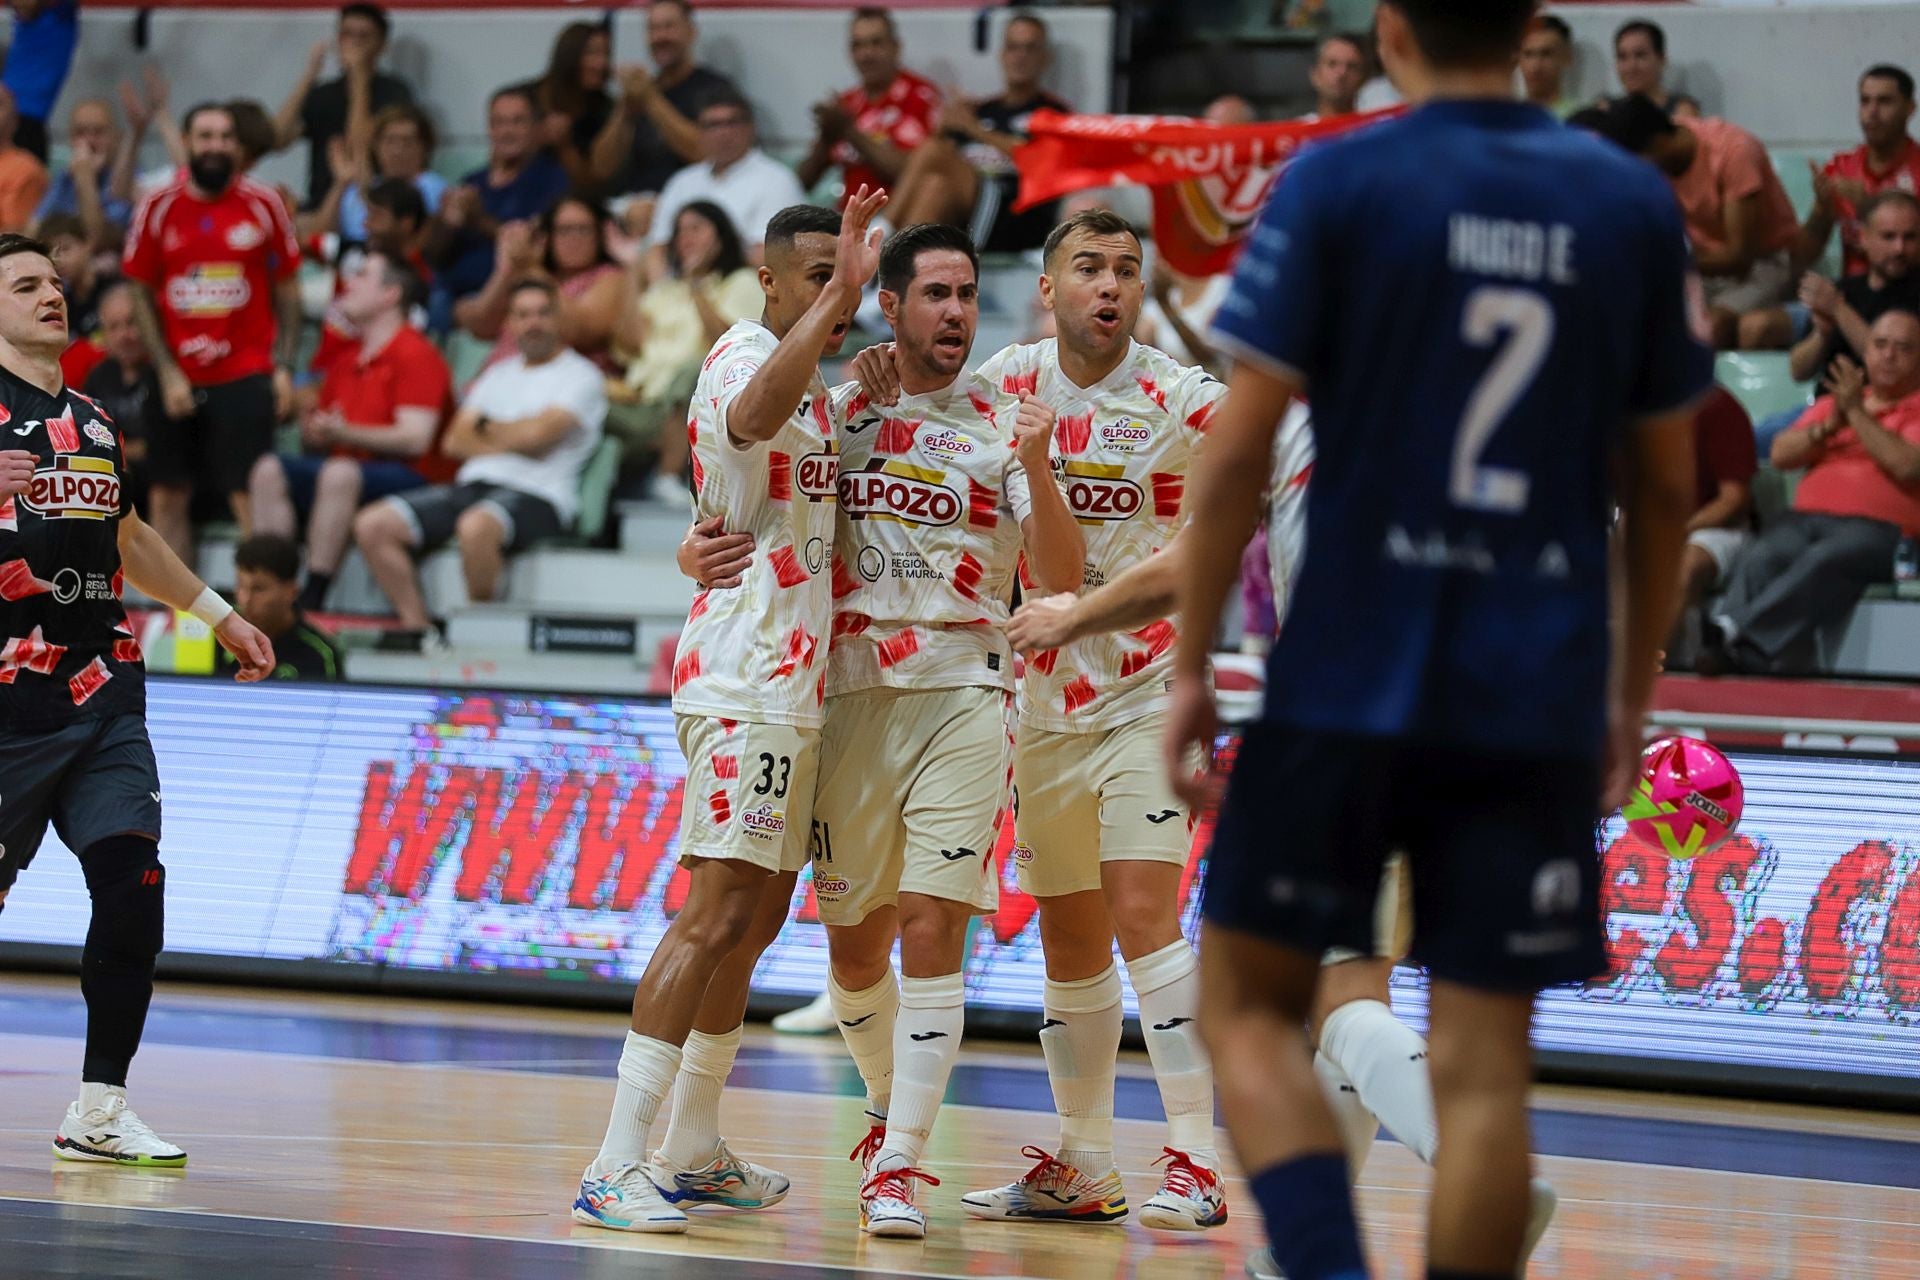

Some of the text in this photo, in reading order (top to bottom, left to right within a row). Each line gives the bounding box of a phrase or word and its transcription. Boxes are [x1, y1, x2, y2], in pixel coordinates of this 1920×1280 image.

[1451, 285, 1556, 514] 2
[1069, 483, 1139, 513] OZO
[891, 568, 903, 578] DE
[754, 752, 791, 798] 33
[743, 830, 773, 841] FUTSAL
[142, 869, 160, 886] 18
